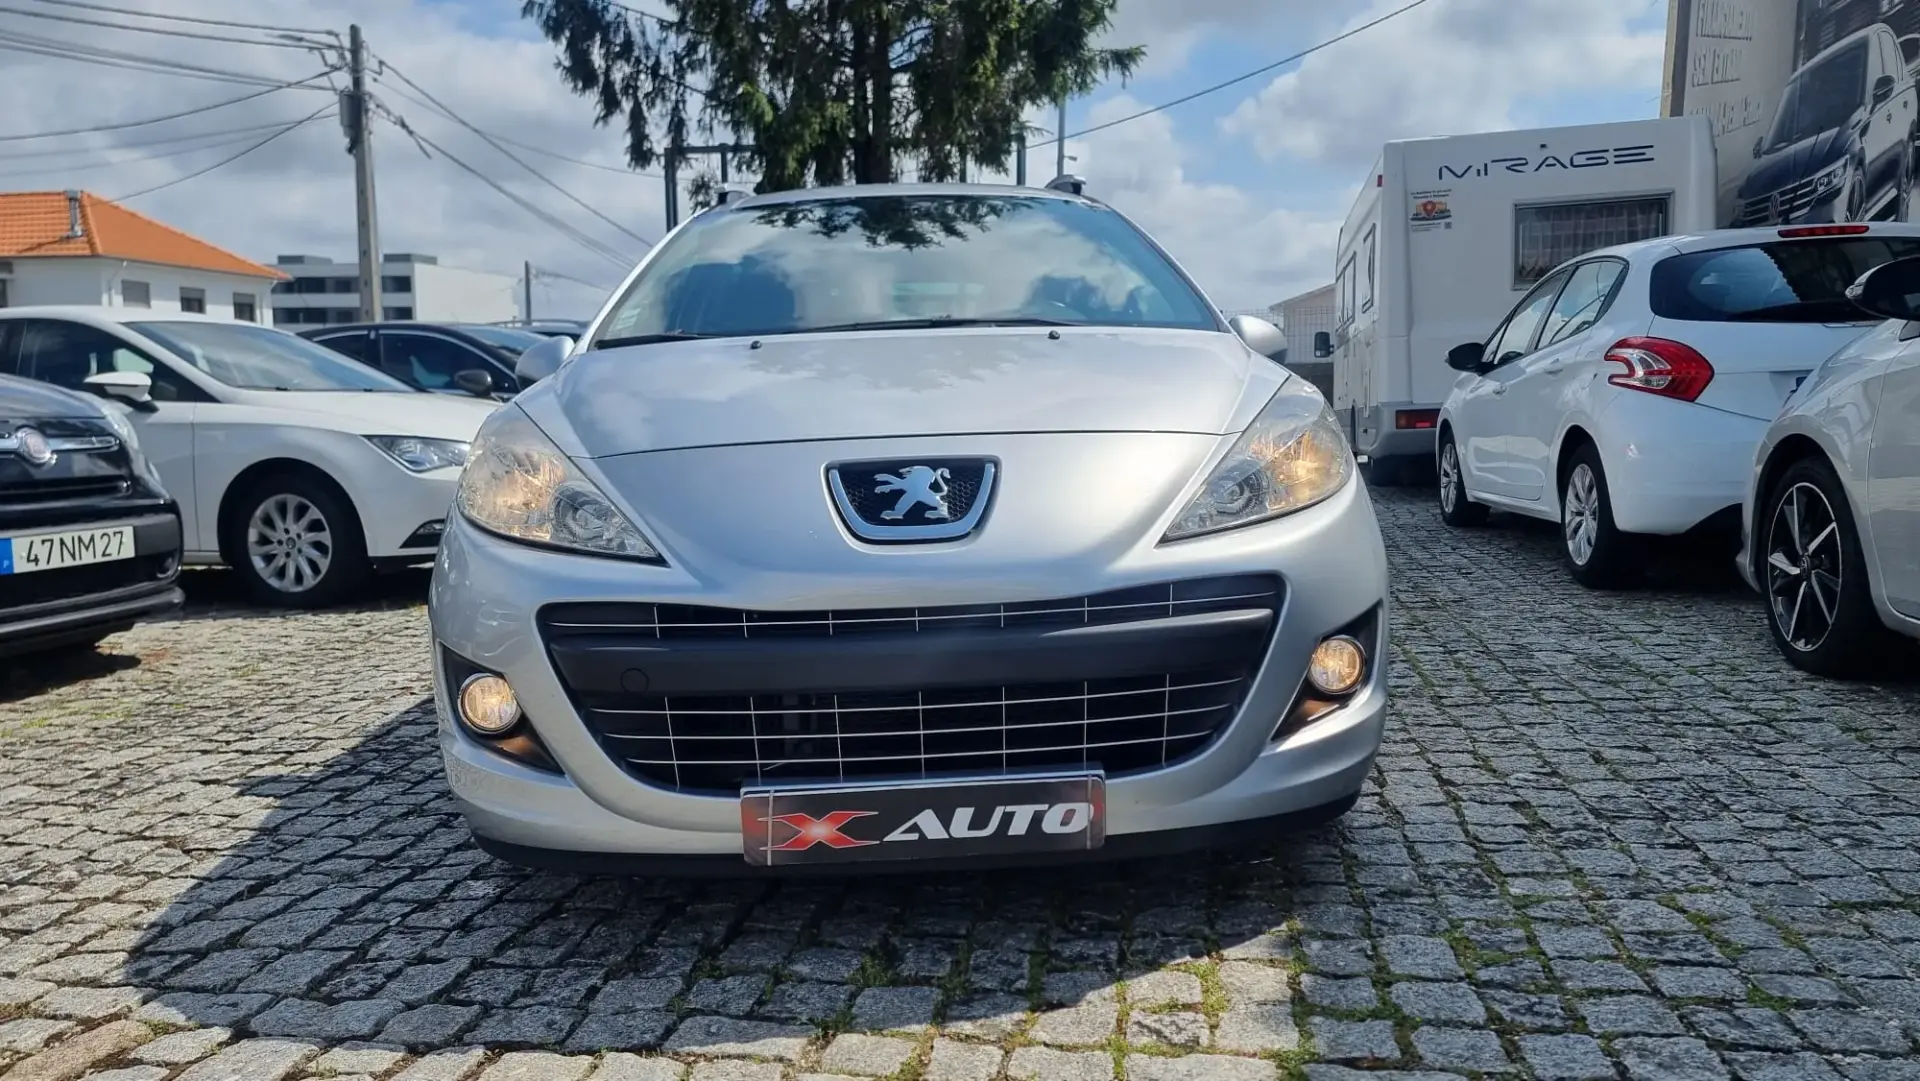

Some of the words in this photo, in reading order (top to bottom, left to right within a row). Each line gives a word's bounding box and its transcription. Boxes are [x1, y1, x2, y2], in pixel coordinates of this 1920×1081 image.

[1438, 144, 1655, 181] MIRAGE
[757, 811, 881, 850] X
[883, 802, 1095, 842] AUTO
